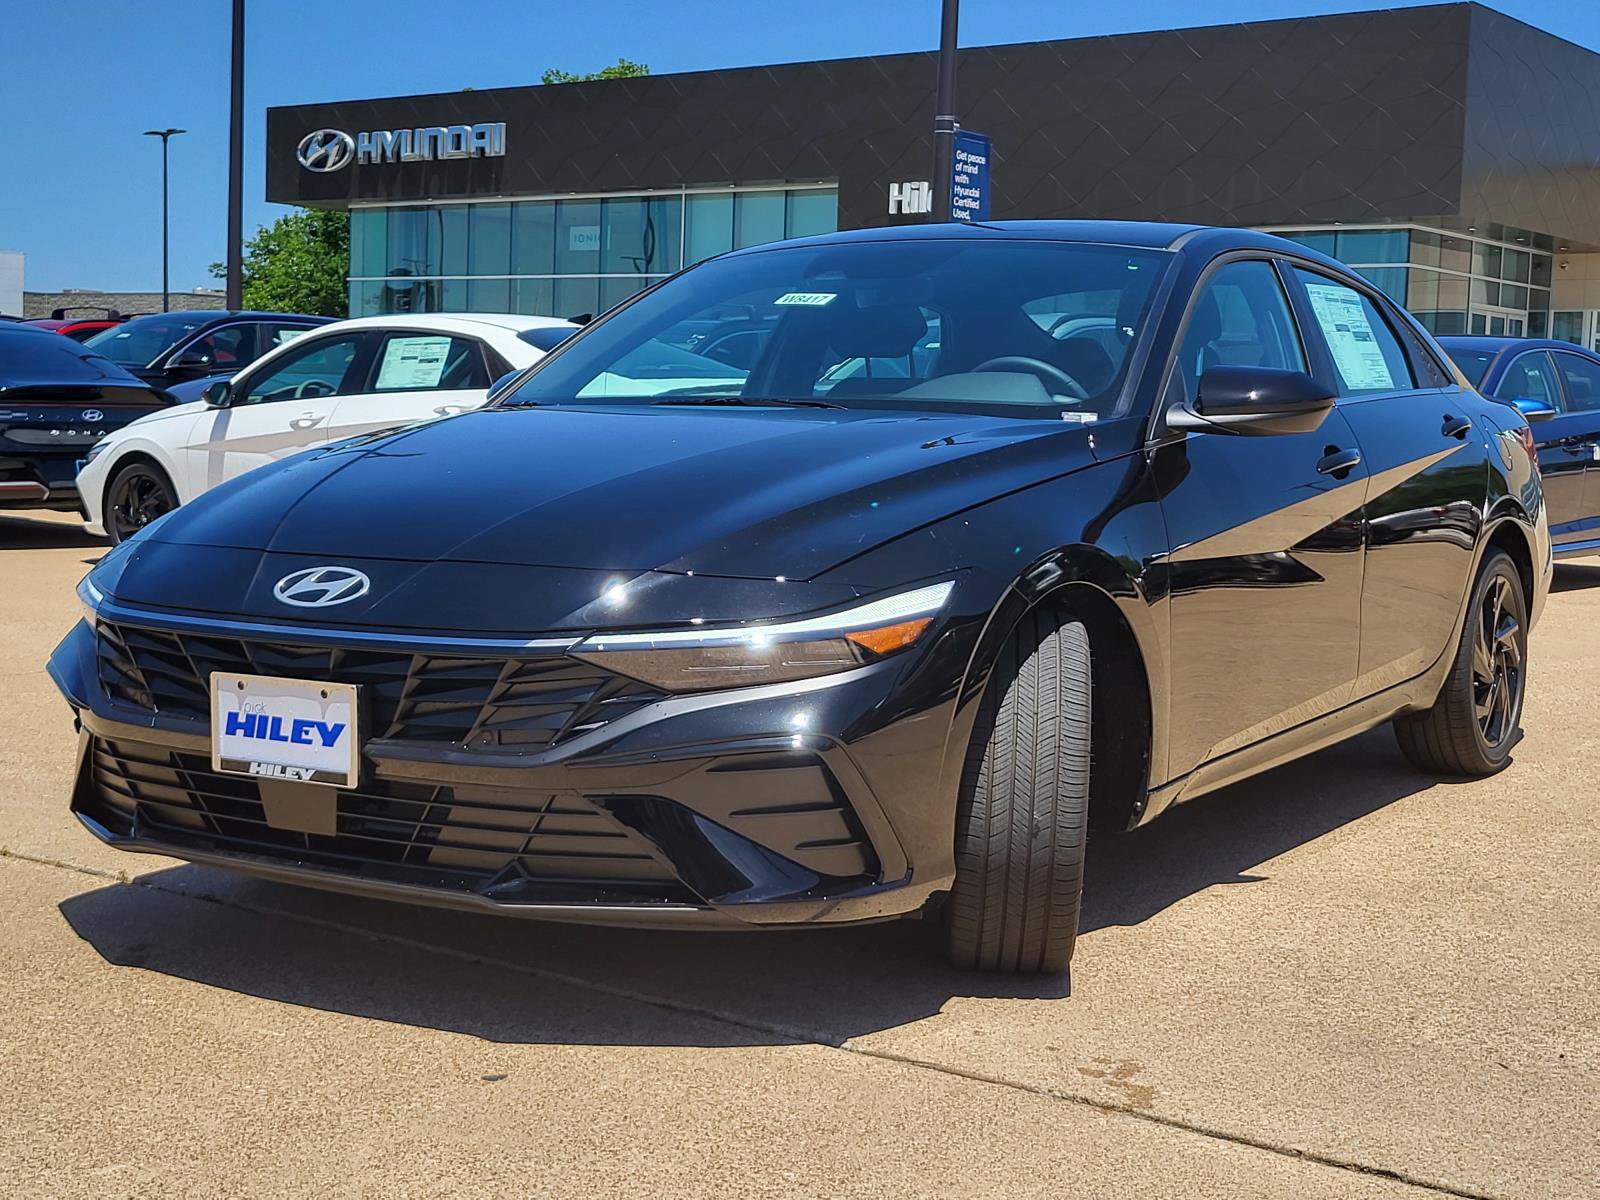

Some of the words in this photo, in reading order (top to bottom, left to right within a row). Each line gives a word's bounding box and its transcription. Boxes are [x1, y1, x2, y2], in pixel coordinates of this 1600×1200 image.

[357, 122, 507, 165] HYUNDAI
[956, 150, 967, 160] Get
[967, 155, 986, 165] peace
[955, 162, 963, 172] of
[963, 164, 979, 175] mind
[954, 174, 970, 184] with
[953, 185, 980, 198] Hyundai
[953, 197, 980, 209] Certified
[225, 711, 346, 748] HILEY
[249, 761, 317, 780] HILEY
